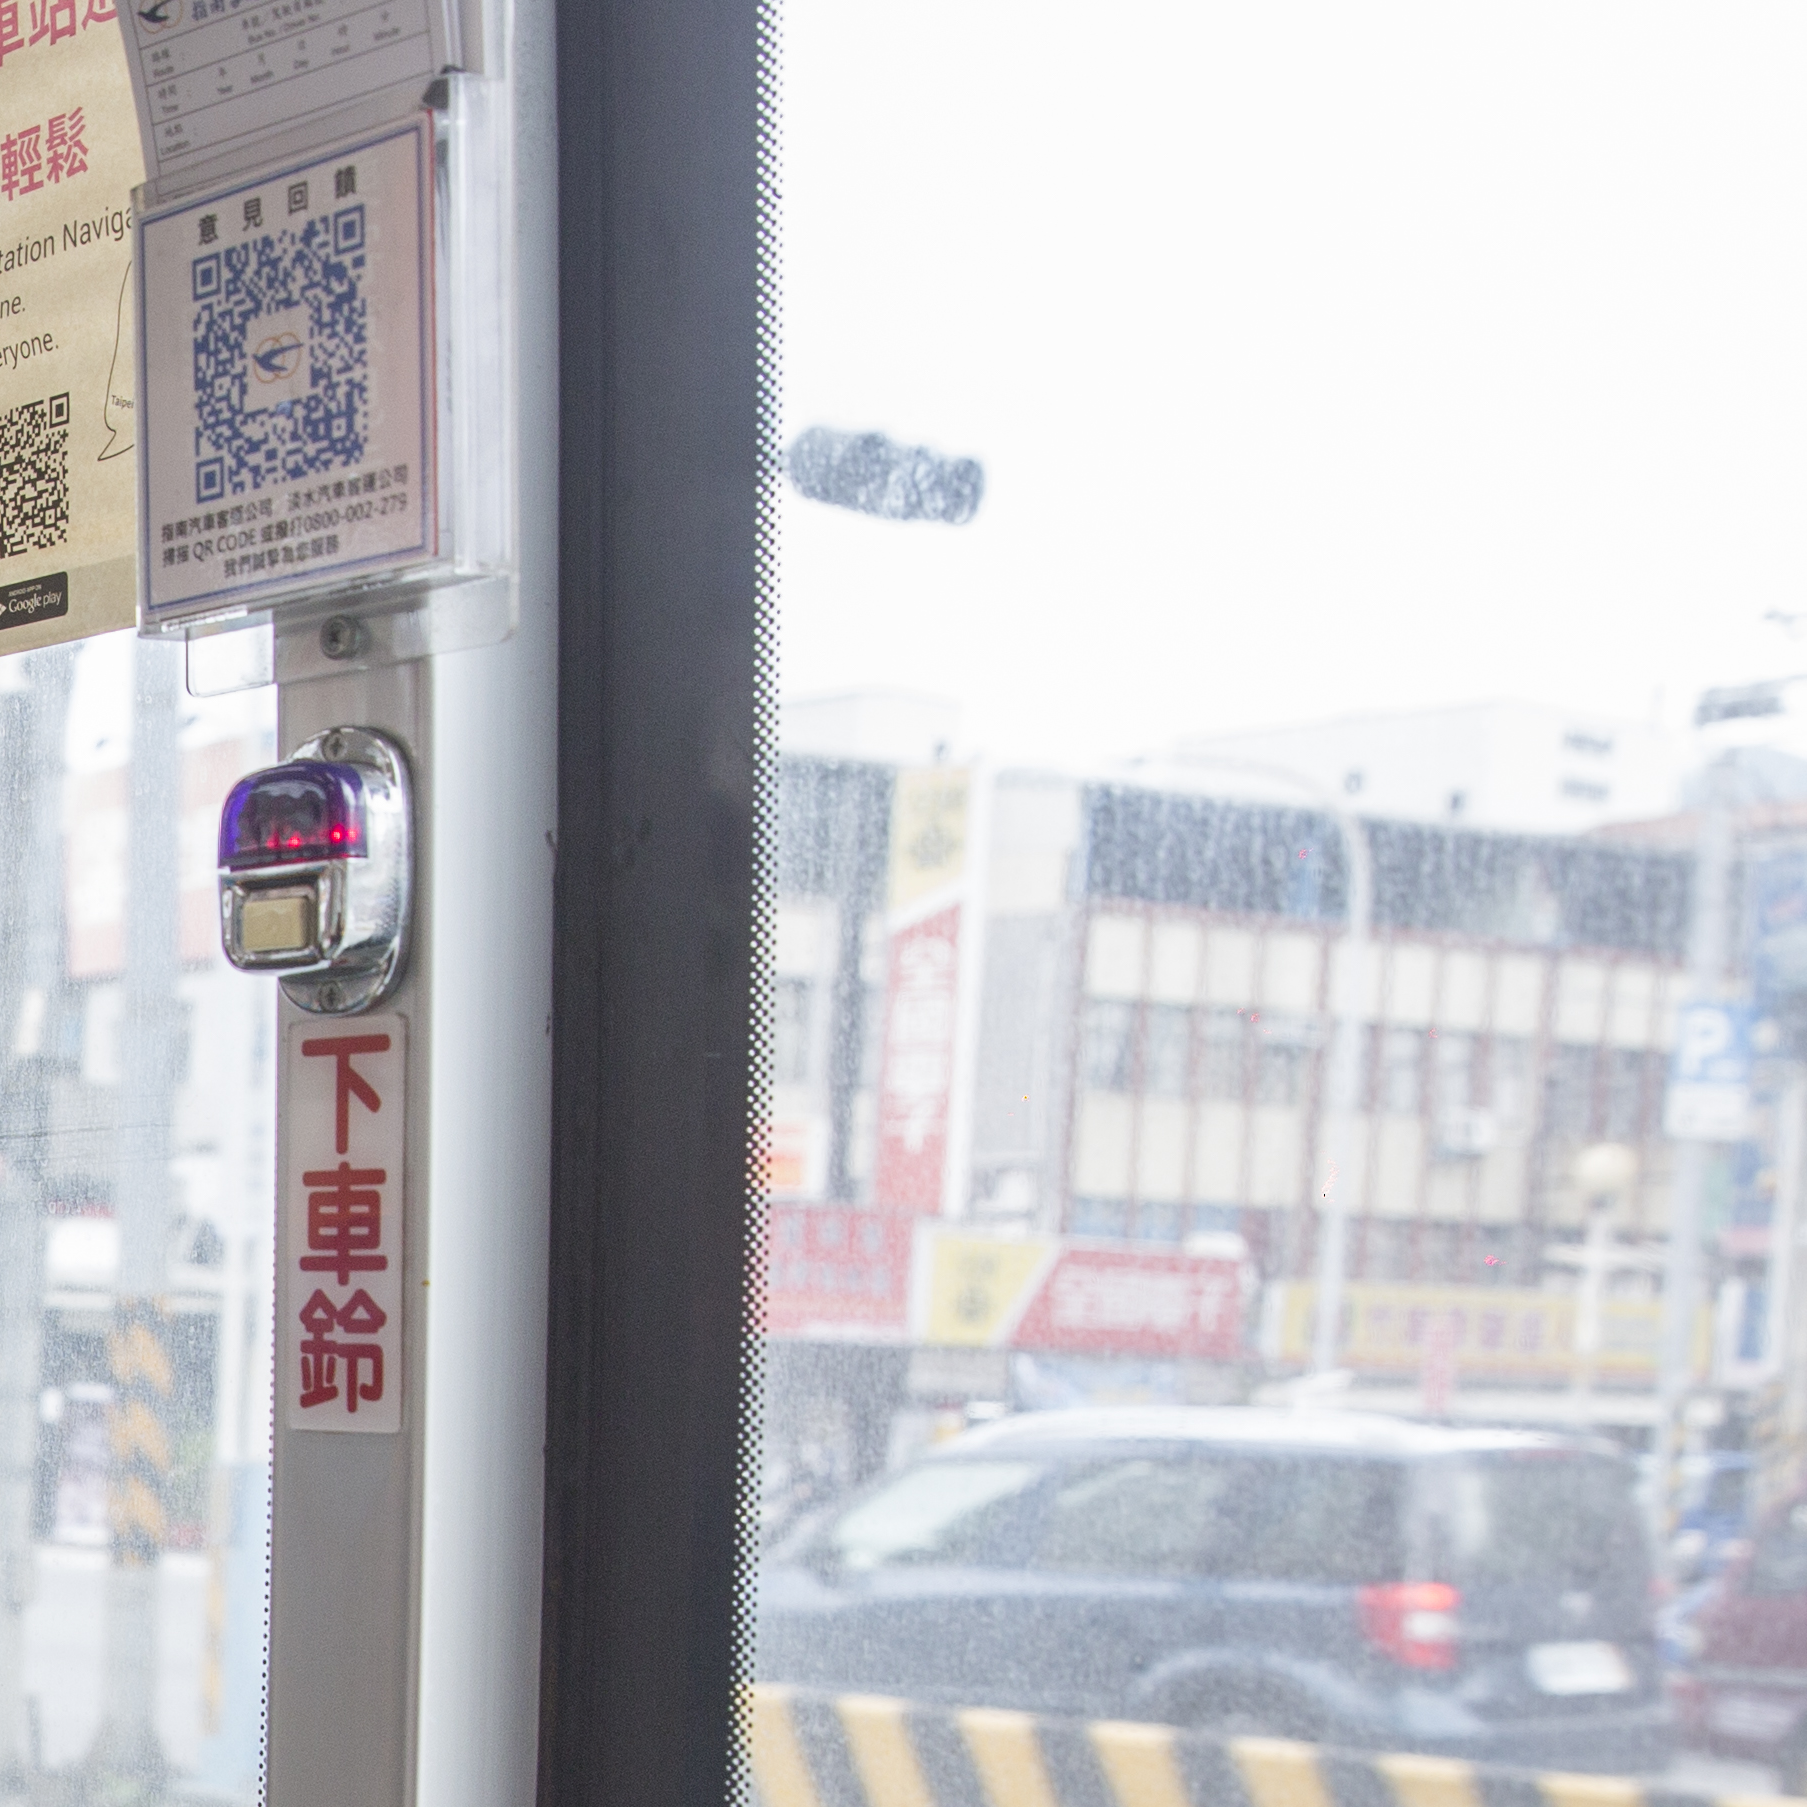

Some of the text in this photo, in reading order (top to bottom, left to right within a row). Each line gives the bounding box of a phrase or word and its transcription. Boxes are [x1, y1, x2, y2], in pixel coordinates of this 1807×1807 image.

[193, 540, 214, 563] QR
[216, 528, 257, 552] CODE
[8, 590, 63, 614] Google play
[299, 1033, 391, 1412] 下車鈴
